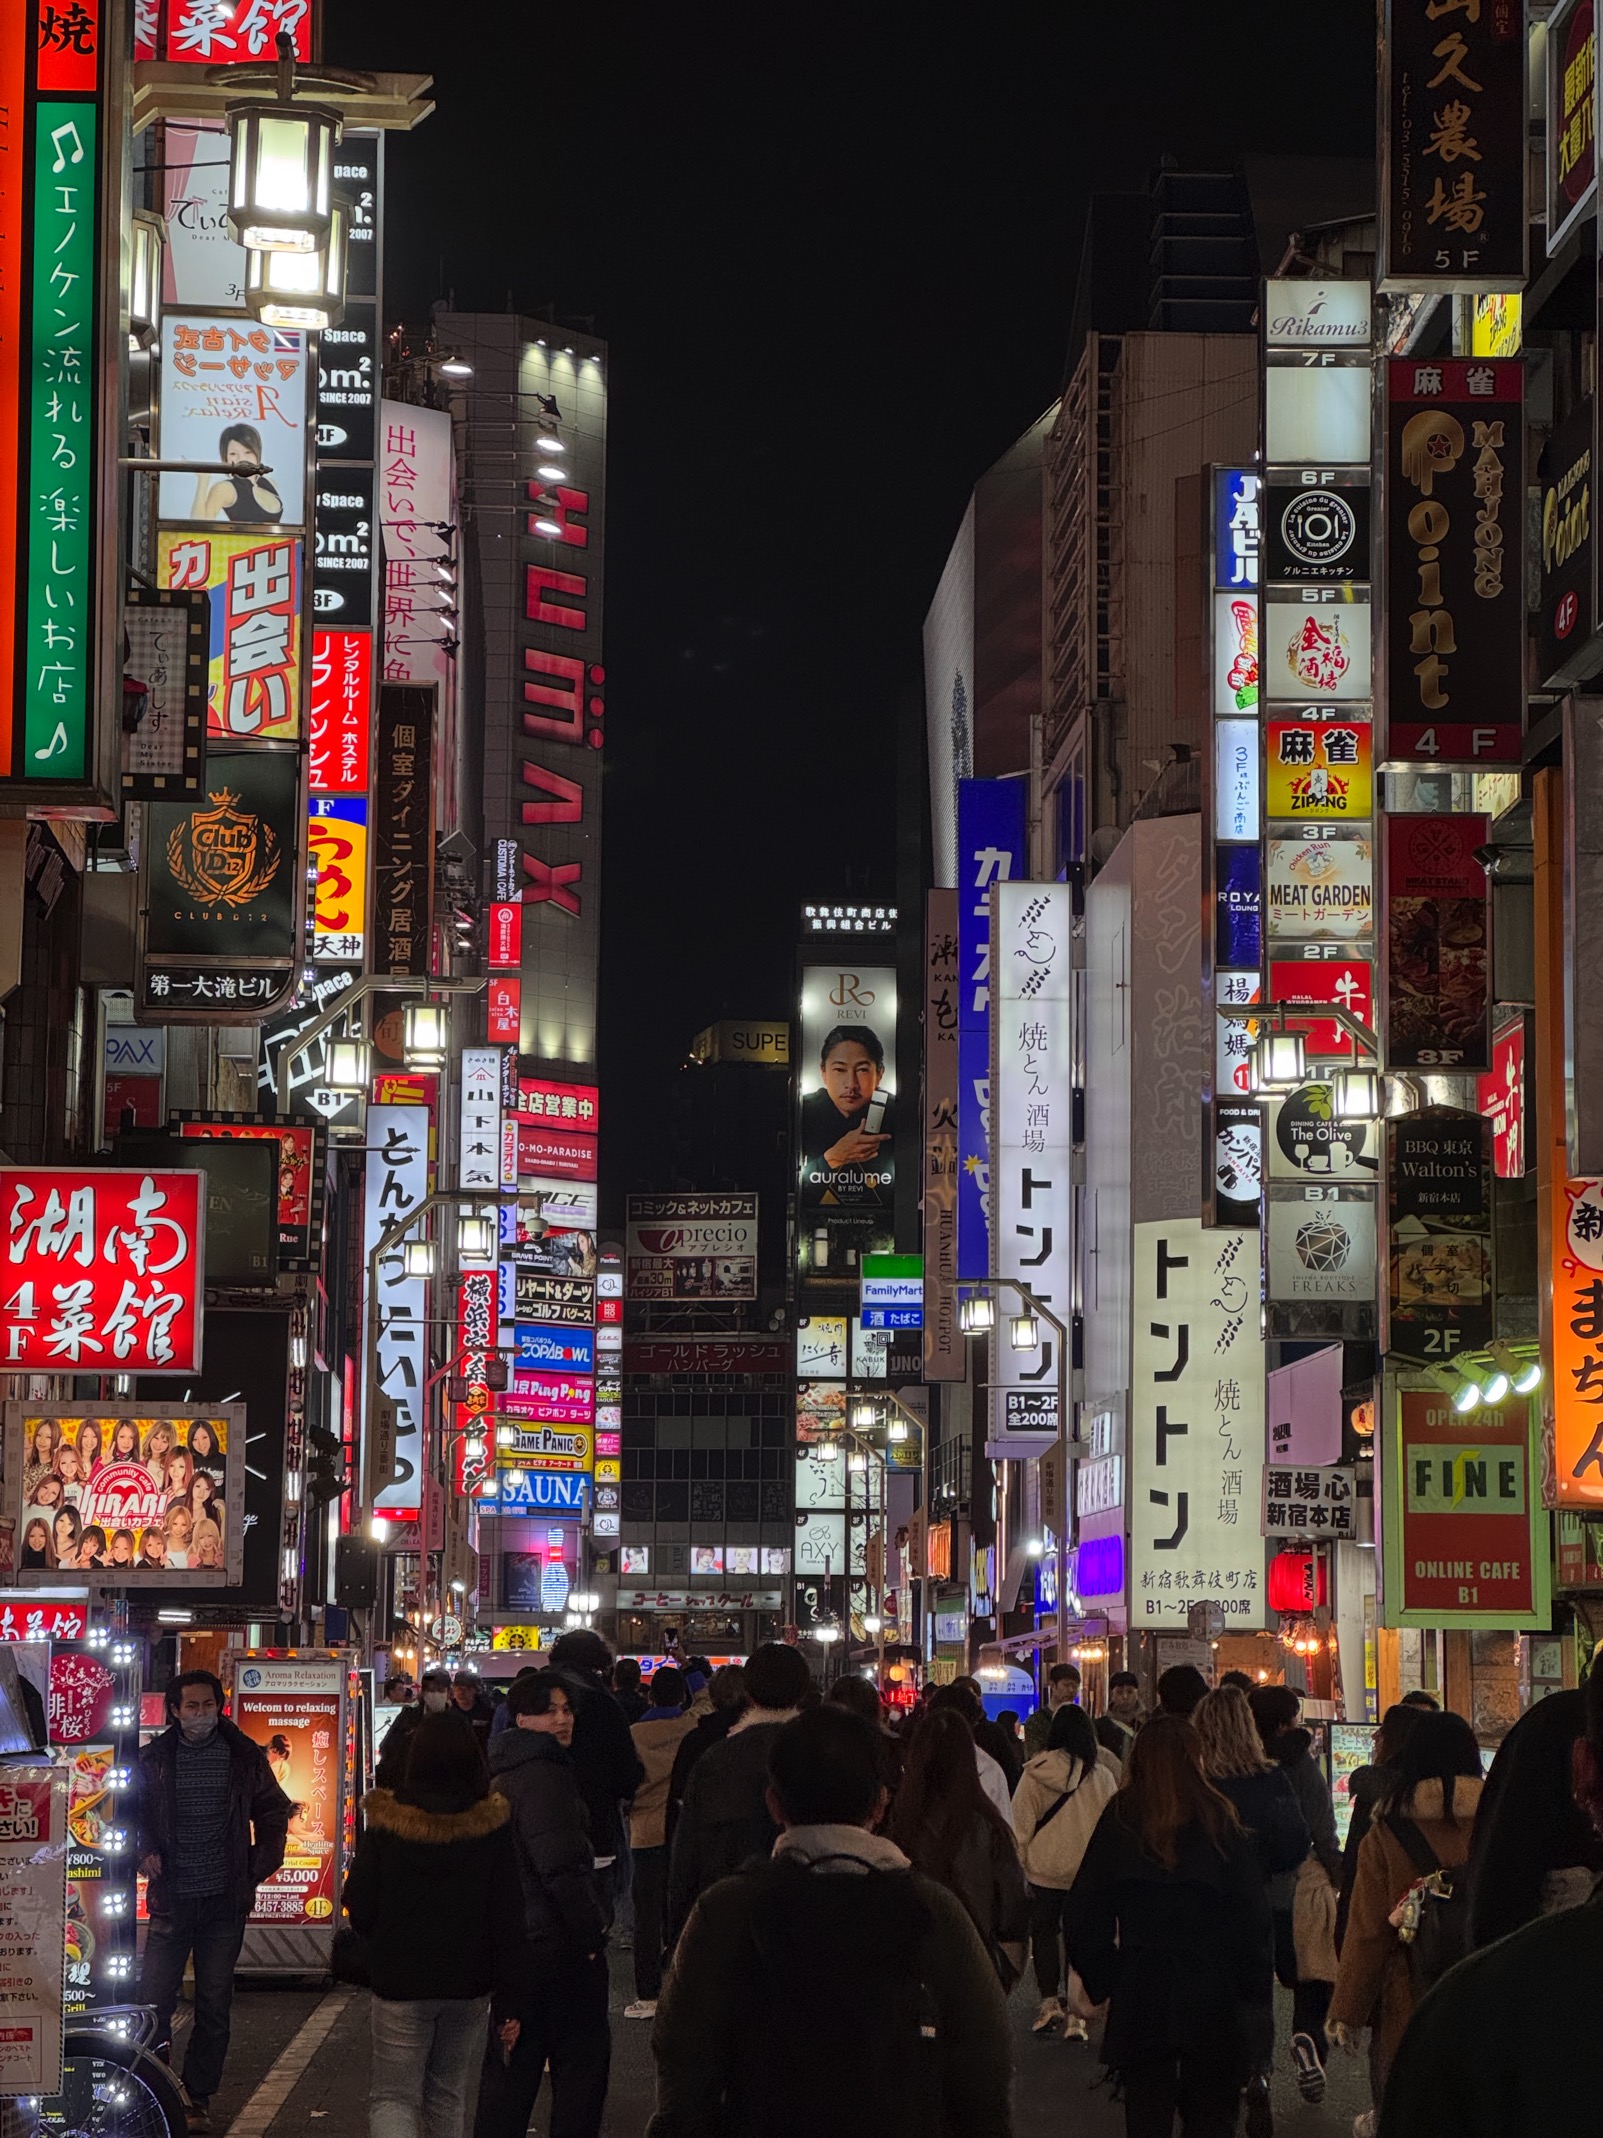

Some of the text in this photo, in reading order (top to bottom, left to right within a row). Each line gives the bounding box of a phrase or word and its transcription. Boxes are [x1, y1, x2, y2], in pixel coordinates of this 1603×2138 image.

[38, 3, 97, 55] 焼
[1269, 315, 1368, 337] Rikamu3
[1302, 353, 1336, 366] 7F
[1414, 366, 1495, 396] 麻雀
[347, 393, 372, 405] 2007
[1301, 470, 1335, 485] 6F
[1471, 421, 1505, 599] MAHJONG
[345, 557, 369, 569] 2007
[1283, 567, 1354, 576] グルニエキッチン
[1302, 588, 1335, 602] 5F
[1558, 594, 1573, 631] 4F
[341, 635, 360, 783] レンタルルーム ホステル
[1302, 707, 1336, 721] 4F
[1279, 729, 1358, 765] 麻雀
[1415, 728, 1497, 756] 4F
[199, 825, 253, 850] Club
[1302, 826, 1337, 839] 3F
[1270, 884, 1371, 907] MEAT GARDEN
[174, 911, 223, 921] CLUB
[805, 906, 899, 919] 歌舞伎町商店街
[1272, 908, 1369, 921] ミートガーデン
[1303, 945, 1338, 960] 2F
[150, 974, 280, 1000] 第一大滝ビル
[837, 1010, 867, 1020] REVI
[1417, 1049, 1464, 1065] 3F
[1017, 1021, 1050, 1153] 焼とん酒場
[318, 1092, 341, 1107] B1
[1219, 1108, 1240, 1116] FOOD
[1290, 1127, 1352, 1141] The Olive
[503, 1132, 515, 1172] カラオケ
[1405, 1140, 1473, 1155] BBQ 東京
[809, 1169, 893, 1185] auralume
[1402, 1160, 1478, 1179] Walton's
[838, 1185, 864, 1193] BY REVI
[1305, 1186, 1340, 1201] B1
[1418, 1191, 1461, 1204] 新宿本店
[631, 1200, 754, 1216] コミック&ネットカフェ
[659, 1222, 747, 1251] aprecio
[1421, 1244, 1460, 1257] 個室
[865, 1285, 923, 1298] FamilyMart
[1292, 1281, 1356, 1292] FREAKS
[870, 1311, 921, 1326] 酒 たばこ
[1423, 1328, 1462, 1353] 2F
[640, 1345, 781, 1359] ゴールドラッシュ
[667, 1358, 735, 1371] ハンバーグ
[531, 1380, 559, 1402] Ping
[1150, 1239, 1189, 1549] トントン
[1426, 1408, 1468, 1427] OPEN
[542, 1428, 573, 1452] PANIC
[1213, 1379, 1243, 1525] 焼とん酒場
[98, 1467, 139, 1493] community
[1267, 1470, 1351, 1501] 酒場心
[1415, 1460, 1517, 1498] FINE
[502, 1474, 584, 1505] SAUNA
[480, 1506, 497, 1514] SPA
[1266, 1502, 1351, 1529] 新宿本店
[100, 1516, 164, 1528] 出会いカフェ
[801, 1541, 840, 1560] AXY
[1415, 1561, 1521, 1580] ONLINE CAFE
[1140, 1570, 1258, 1590] 新宿歌舞伎町店
[717, 1592, 755, 1608] クール
[1458, 1586, 1479, 1604] B1
[264, 1670, 336, 1680] Aroma Relaxation
[243, 1702, 337, 1716] Welcom to relaxing
[268, 1717, 311, 1729] massage
[276, 1869, 319, 1884] ¥5,000
